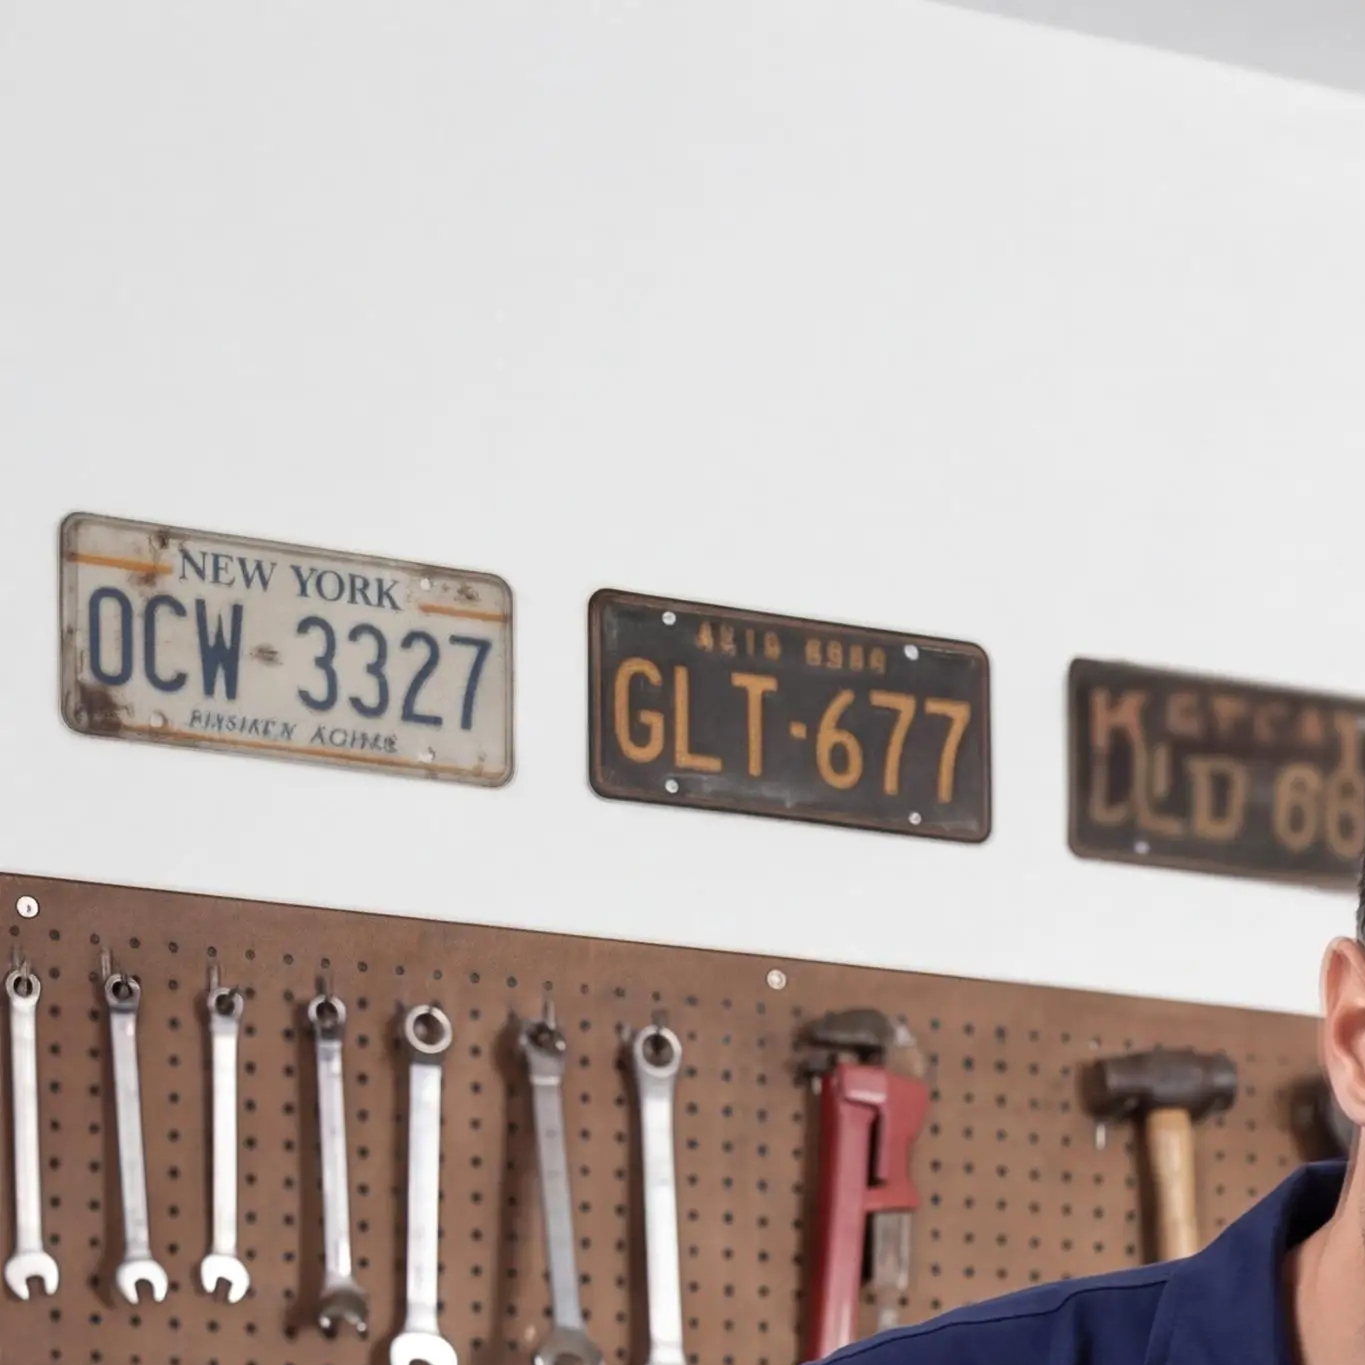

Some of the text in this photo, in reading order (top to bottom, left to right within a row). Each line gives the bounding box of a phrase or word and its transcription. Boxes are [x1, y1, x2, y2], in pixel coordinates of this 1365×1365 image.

[179, 547, 403, 612] NEW YORK
[88, 587, 244, 701] OCW
[295, 616, 493, 731] 3327
